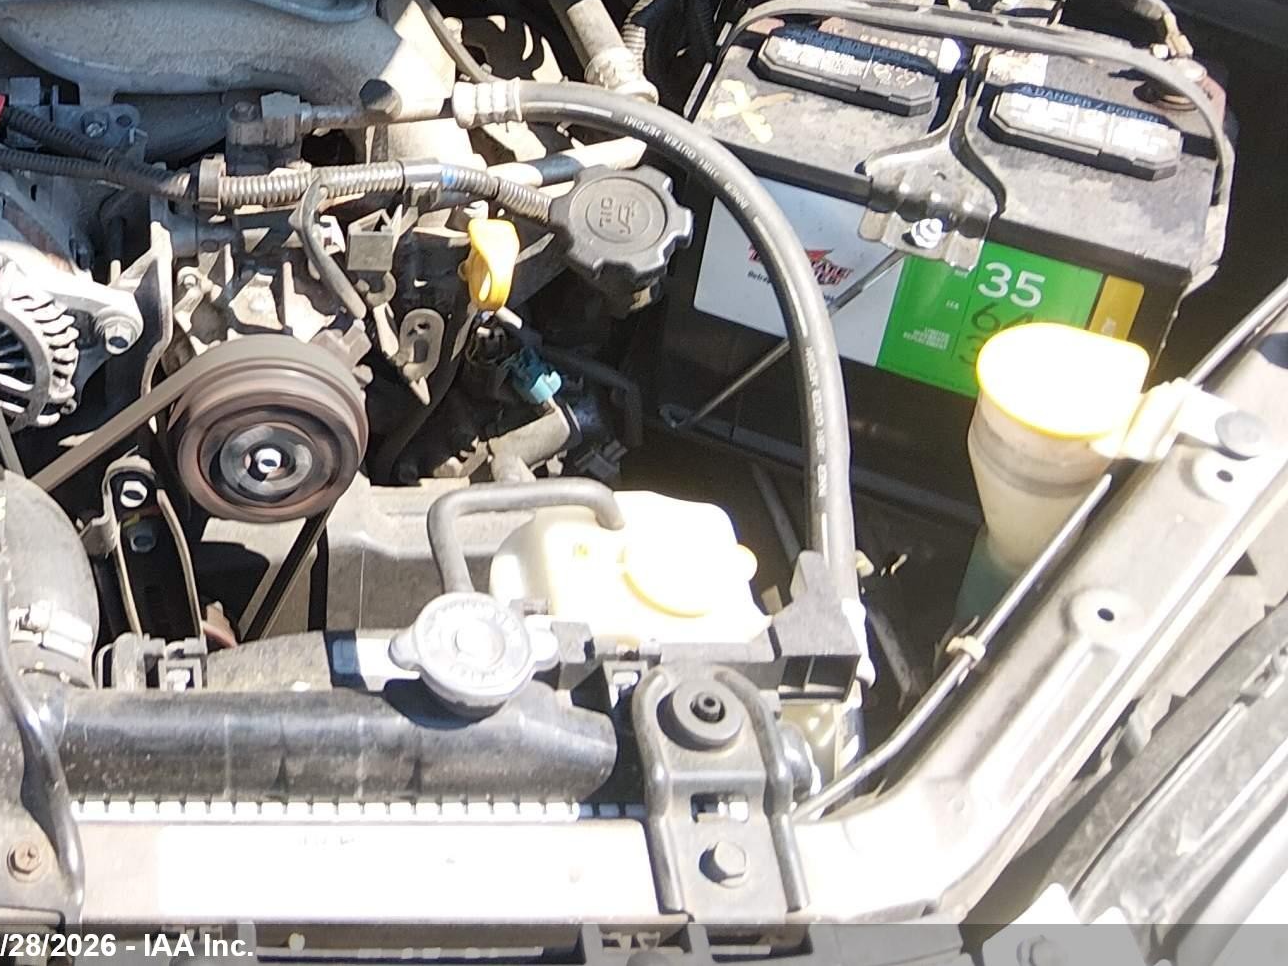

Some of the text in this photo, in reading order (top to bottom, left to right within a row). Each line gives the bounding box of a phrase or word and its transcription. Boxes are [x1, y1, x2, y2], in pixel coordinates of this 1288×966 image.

[663, 133, 697, 161] OUTER
[600, 197, 613, 228] OIL
[977, 261, 1046, 309] 35
